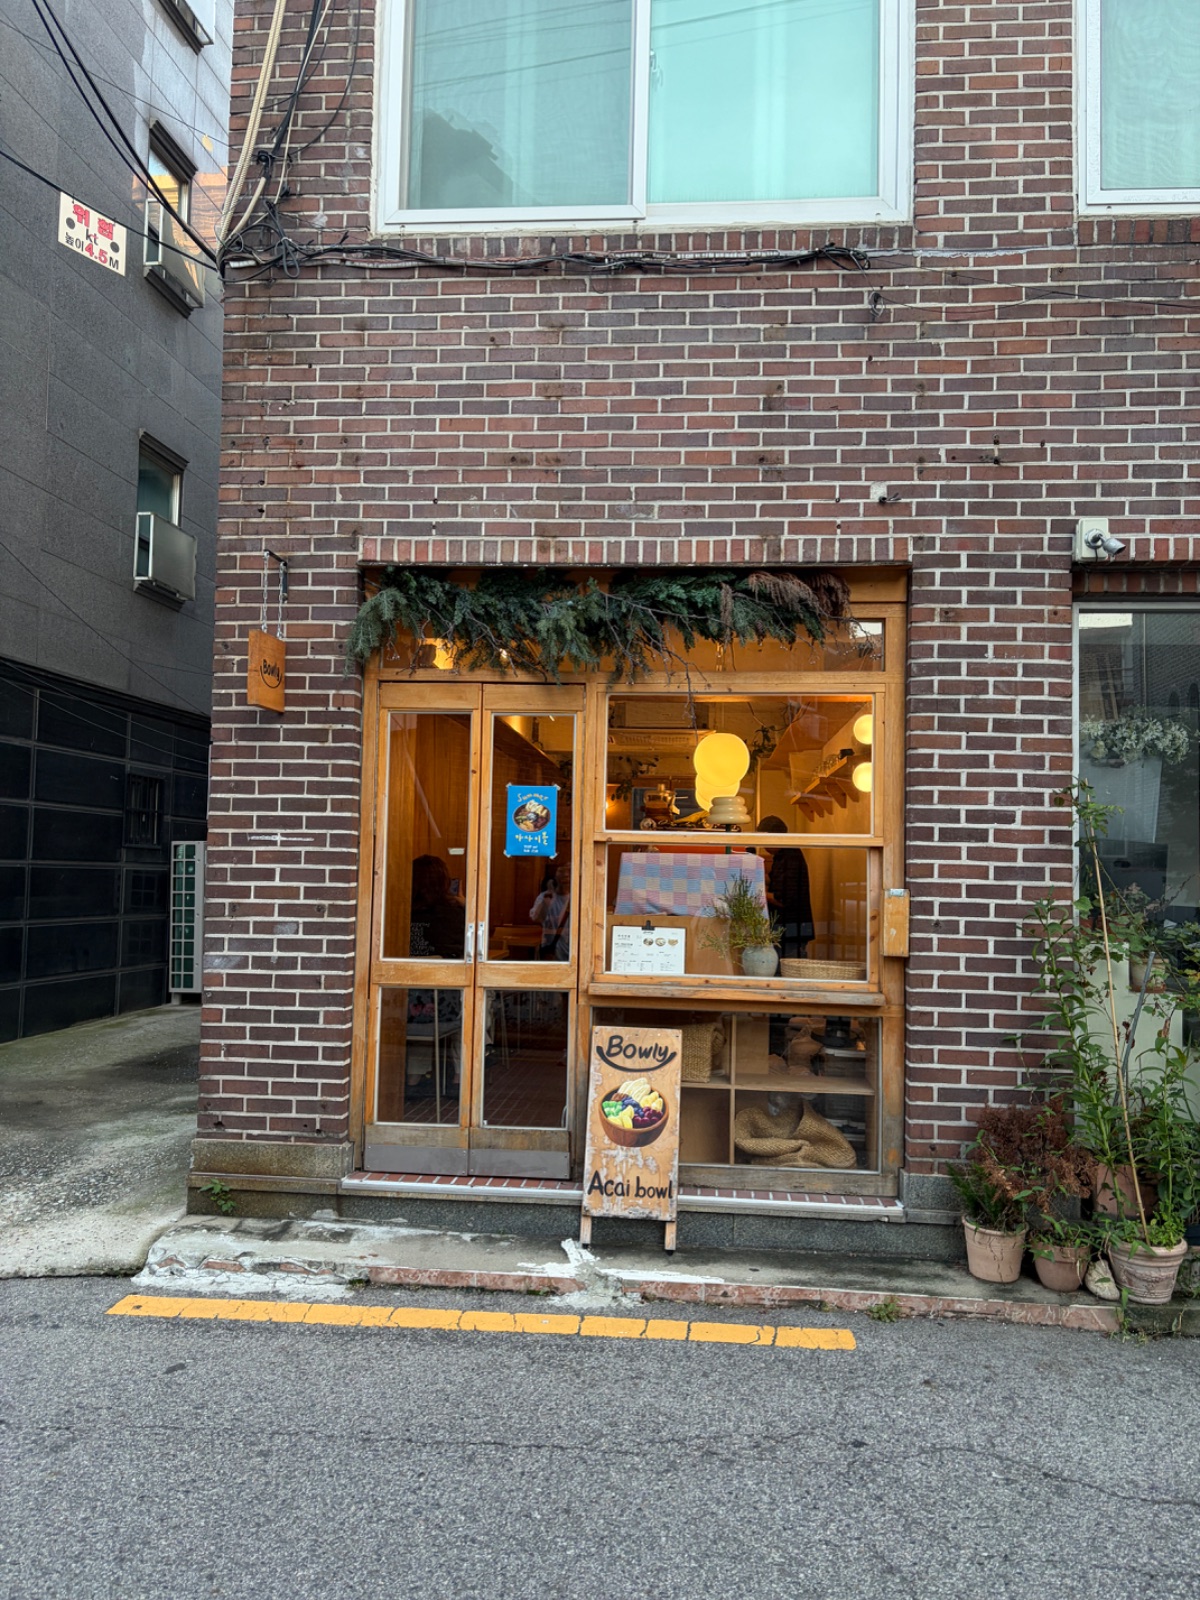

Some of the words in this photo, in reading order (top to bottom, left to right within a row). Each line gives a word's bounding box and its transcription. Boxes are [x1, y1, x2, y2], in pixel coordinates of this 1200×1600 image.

[86, 229, 98, 246] kt
[605, 1035, 669, 1063] Bowly
[587, 1170, 631, 1197] Acai
[634, 1176, 673, 1199] bowl
